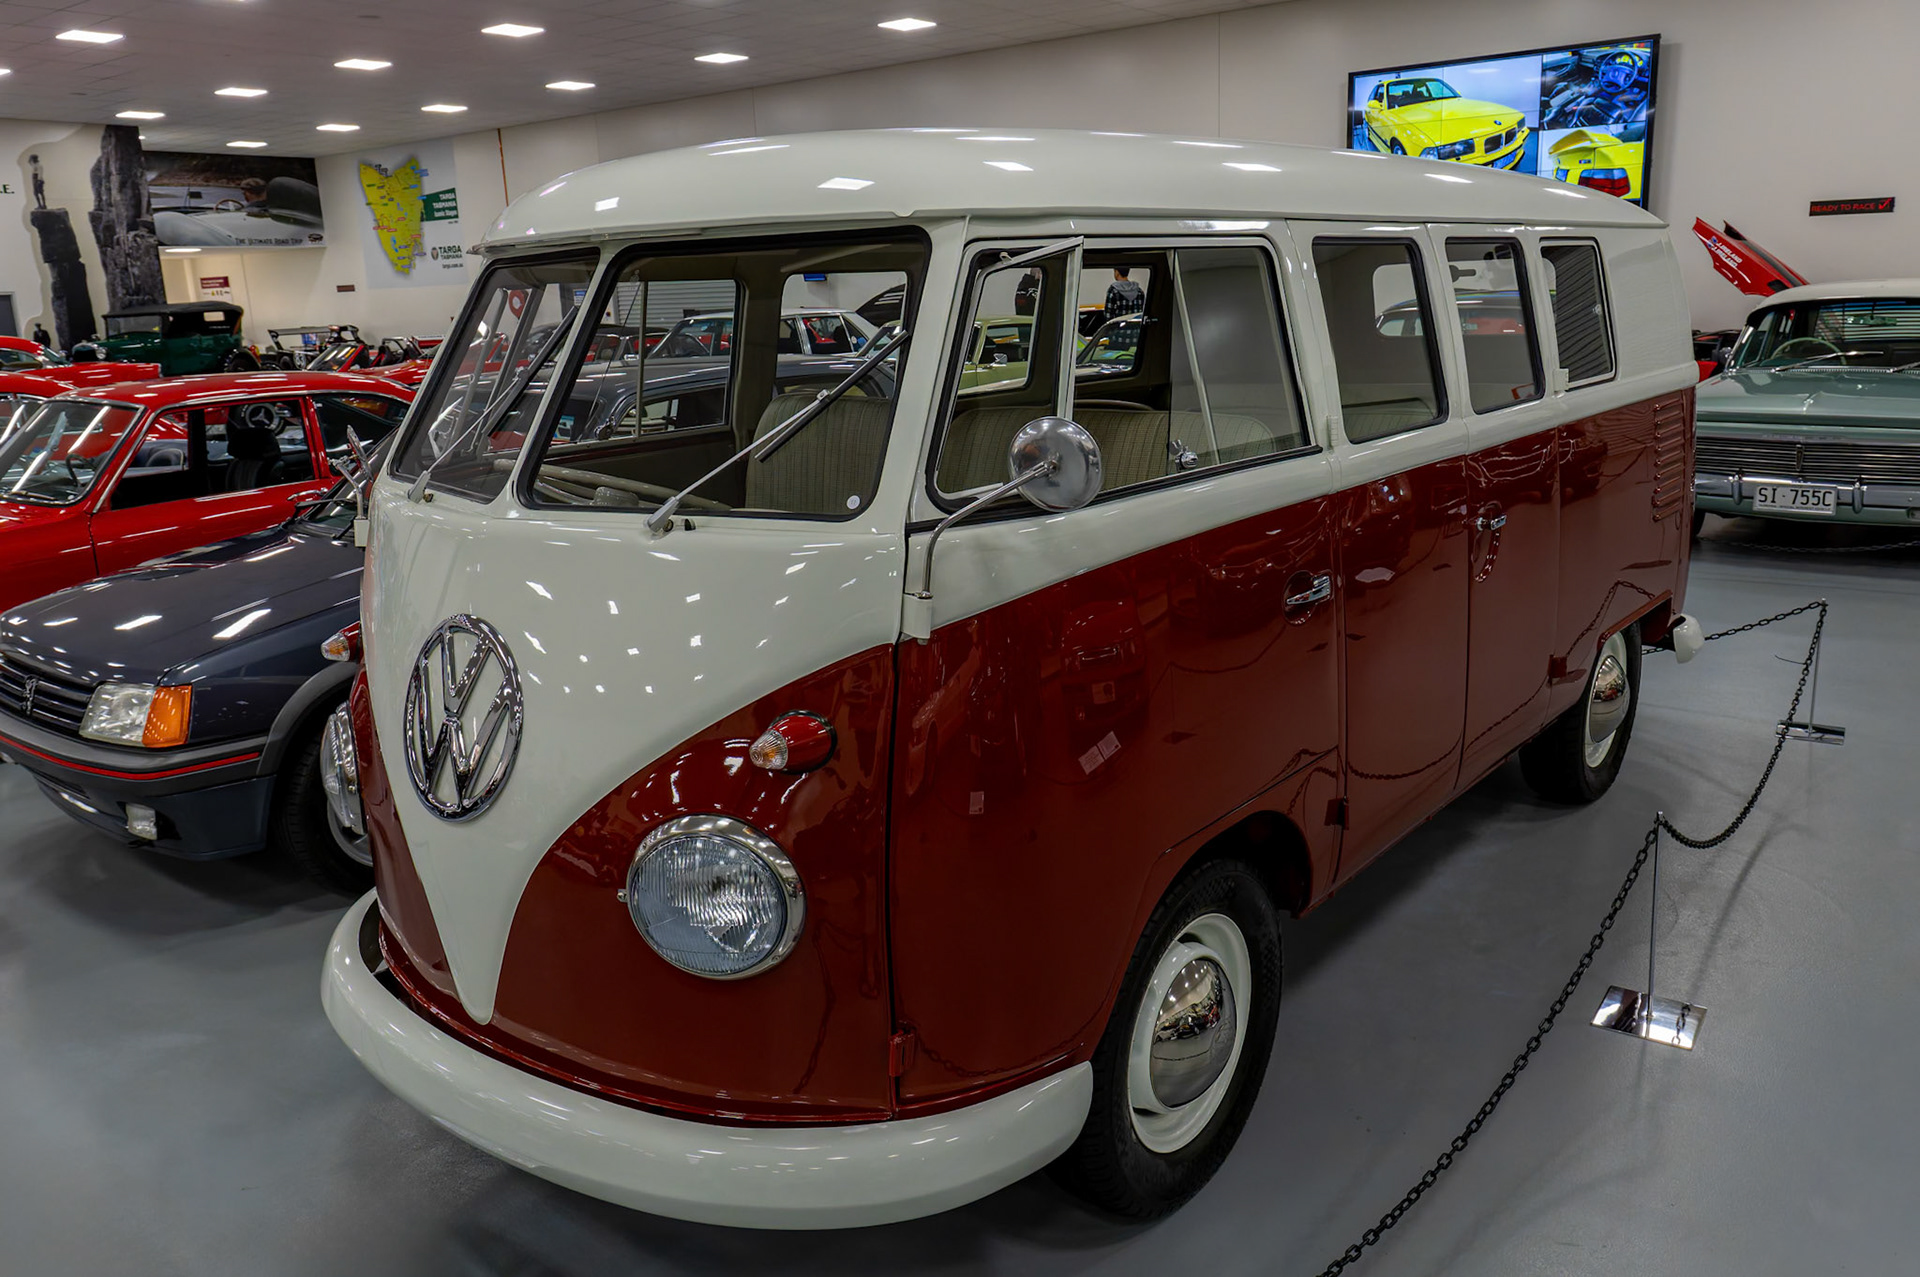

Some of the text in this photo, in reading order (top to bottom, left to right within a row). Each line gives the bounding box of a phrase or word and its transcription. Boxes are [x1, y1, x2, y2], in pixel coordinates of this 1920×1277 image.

[1811, 204, 1838, 212] READY
[1852, 202, 1876, 210] RACE
[438, 245, 462, 254] TARGA
